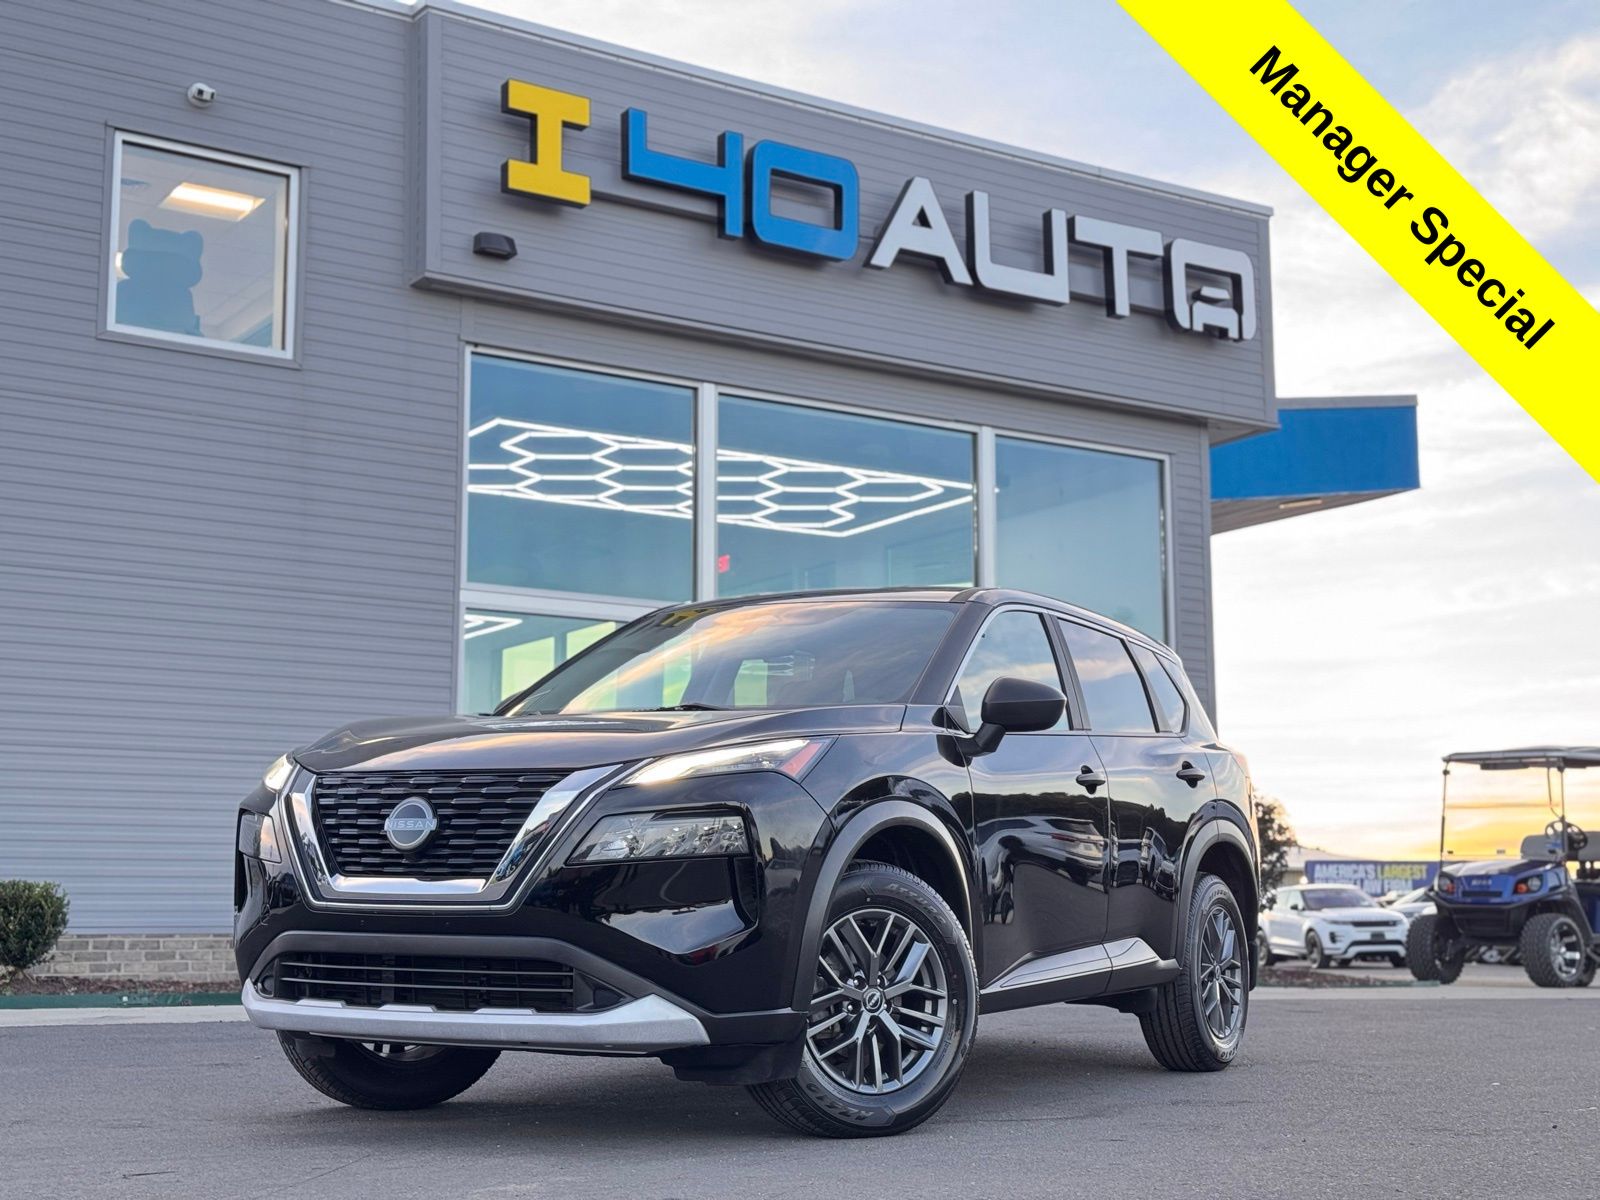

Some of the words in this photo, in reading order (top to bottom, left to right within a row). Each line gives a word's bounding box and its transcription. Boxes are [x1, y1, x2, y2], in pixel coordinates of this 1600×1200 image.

[861, 176, 1257, 341] AUTO
[386, 820, 435, 829] NISSAN
[1314, 864, 1376, 879] AMERICA'S
[1377, 865, 1427, 880] LARGEST
